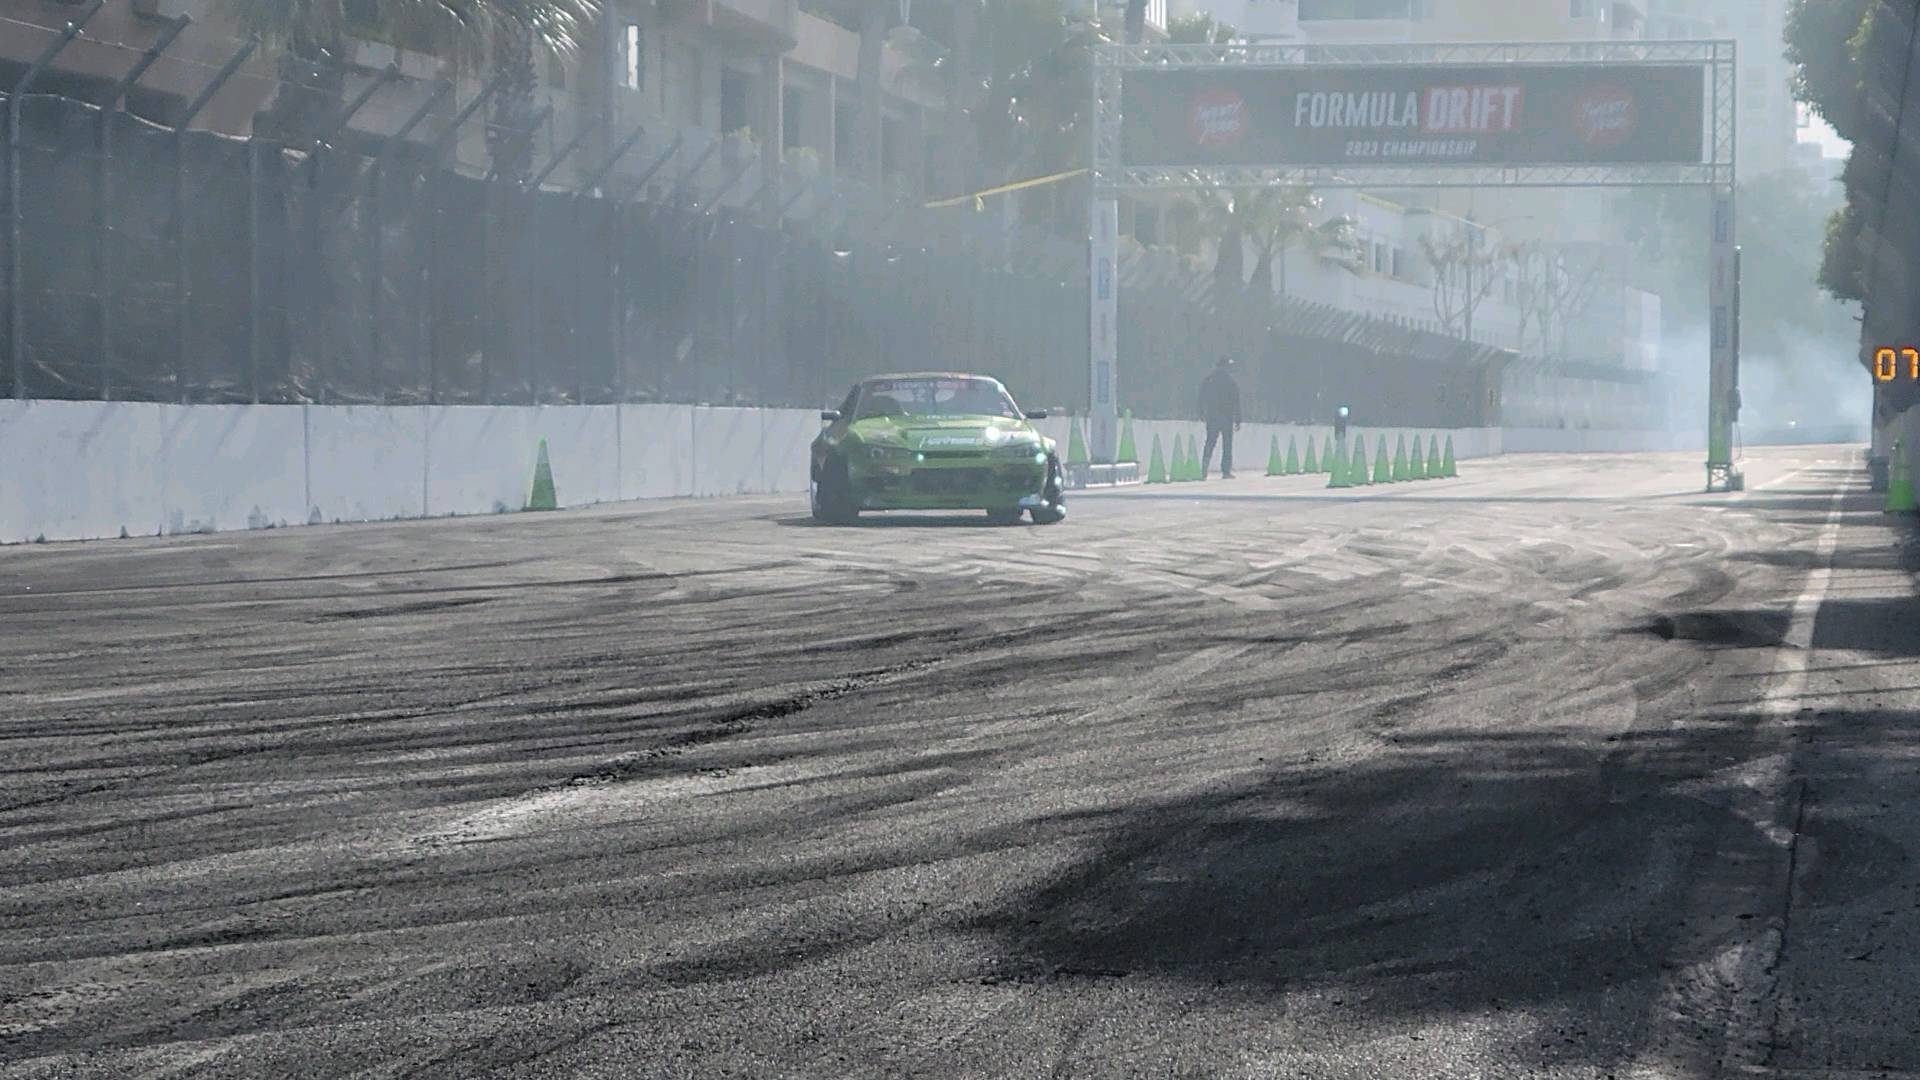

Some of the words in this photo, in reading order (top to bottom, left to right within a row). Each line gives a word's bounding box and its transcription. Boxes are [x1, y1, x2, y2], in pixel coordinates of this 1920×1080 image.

[1295, 91, 1419, 128] FORMULA
[1427, 86, 1520, 130] DRIFT
[1344, 140, 1378, 156] 2023
[1382, 139, 1478, 157] CHAMPIONSHIP
[1876, 348, 1919, 381] 07
